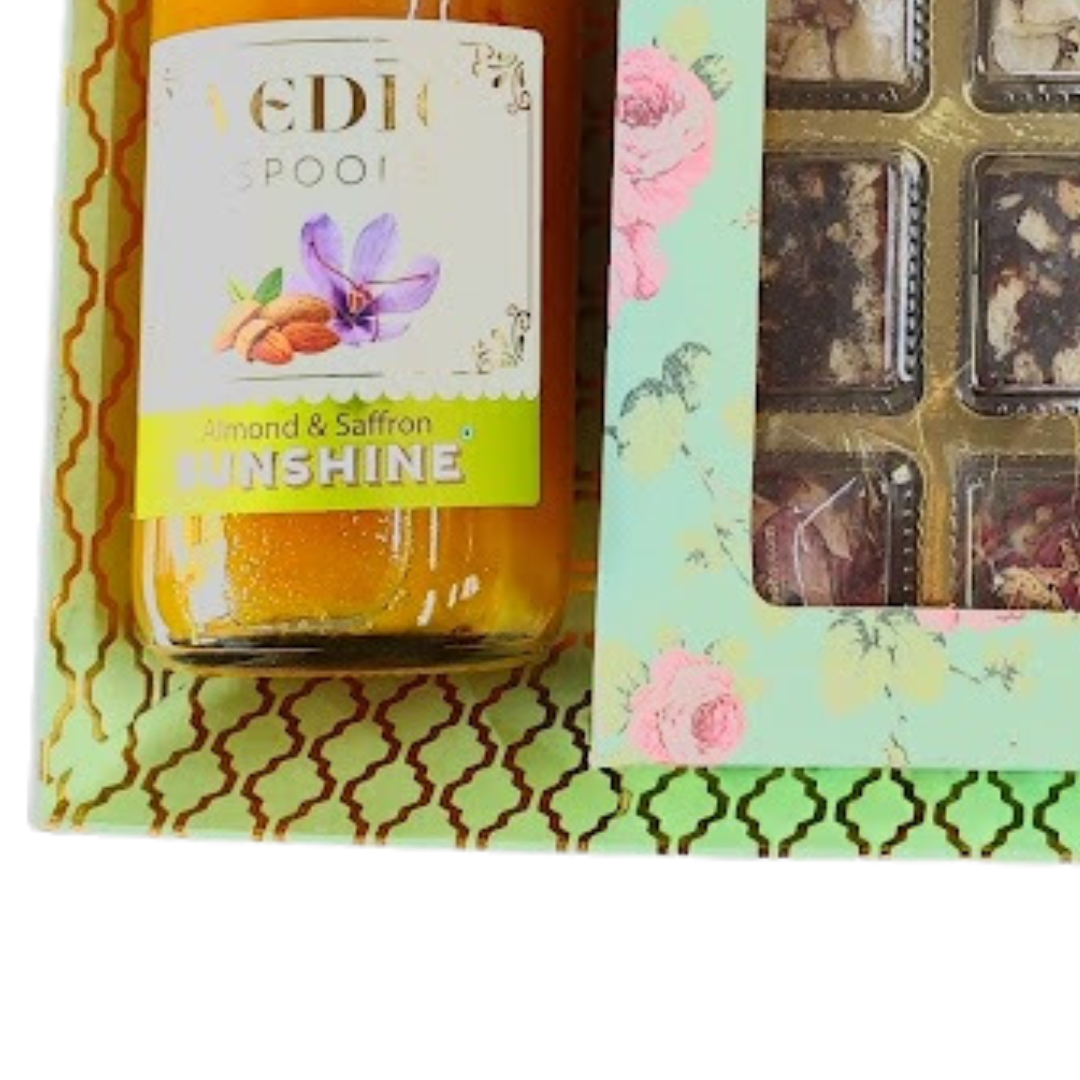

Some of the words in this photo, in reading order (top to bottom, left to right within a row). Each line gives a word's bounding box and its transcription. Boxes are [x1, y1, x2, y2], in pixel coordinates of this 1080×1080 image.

[202, 413, 299, 441] Almond
[307, 413, 328, 437] &
[335, 410, 432, 436] Saffron
